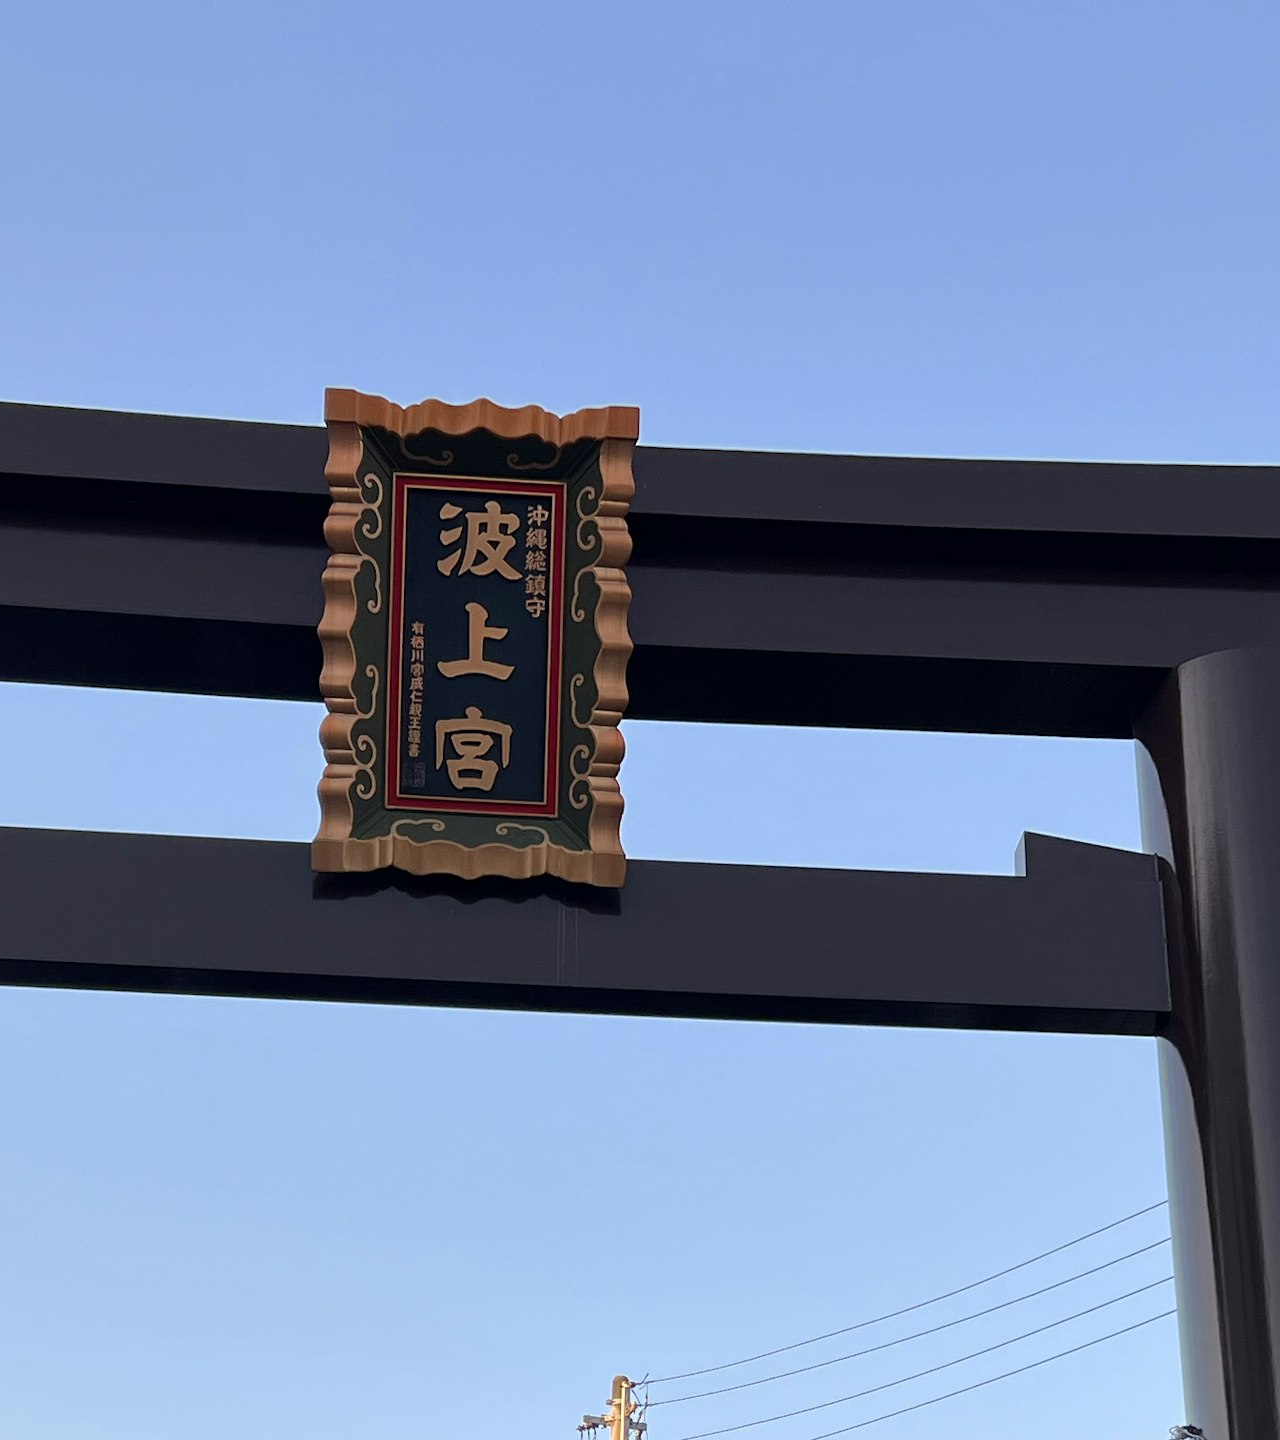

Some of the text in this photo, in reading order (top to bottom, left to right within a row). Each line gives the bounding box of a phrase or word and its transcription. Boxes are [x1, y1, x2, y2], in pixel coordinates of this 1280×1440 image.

[435, 500, 523, 792] 波上宮
[524, 504, 550, 618] 沖縄総鎮守
